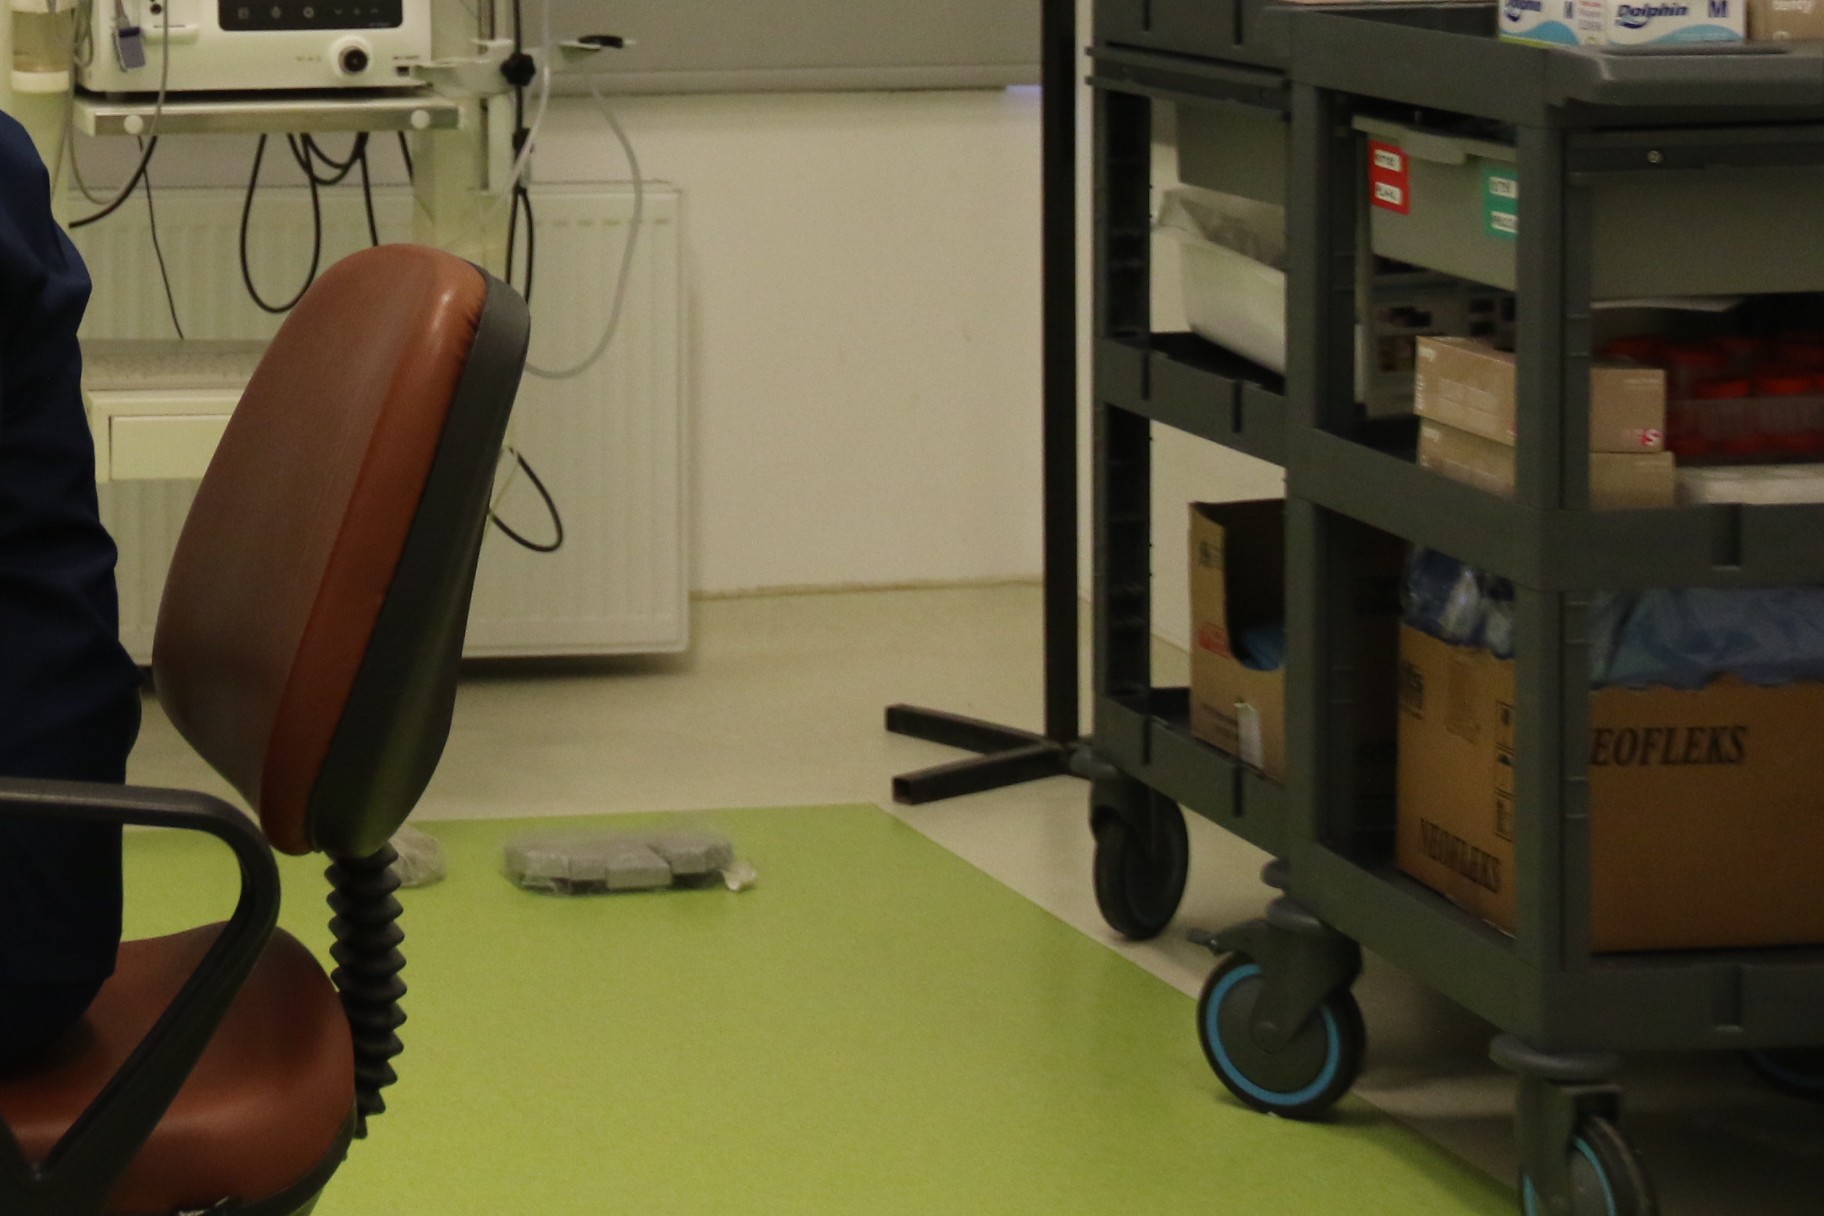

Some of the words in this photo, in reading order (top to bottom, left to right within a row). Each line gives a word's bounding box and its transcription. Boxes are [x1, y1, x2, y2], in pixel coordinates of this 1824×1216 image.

[1616, 3, 1690, 18] Dolphin
[1707, 0, 1729, 18] M
[1589, 725, 1748, 766] EOFLEKS
